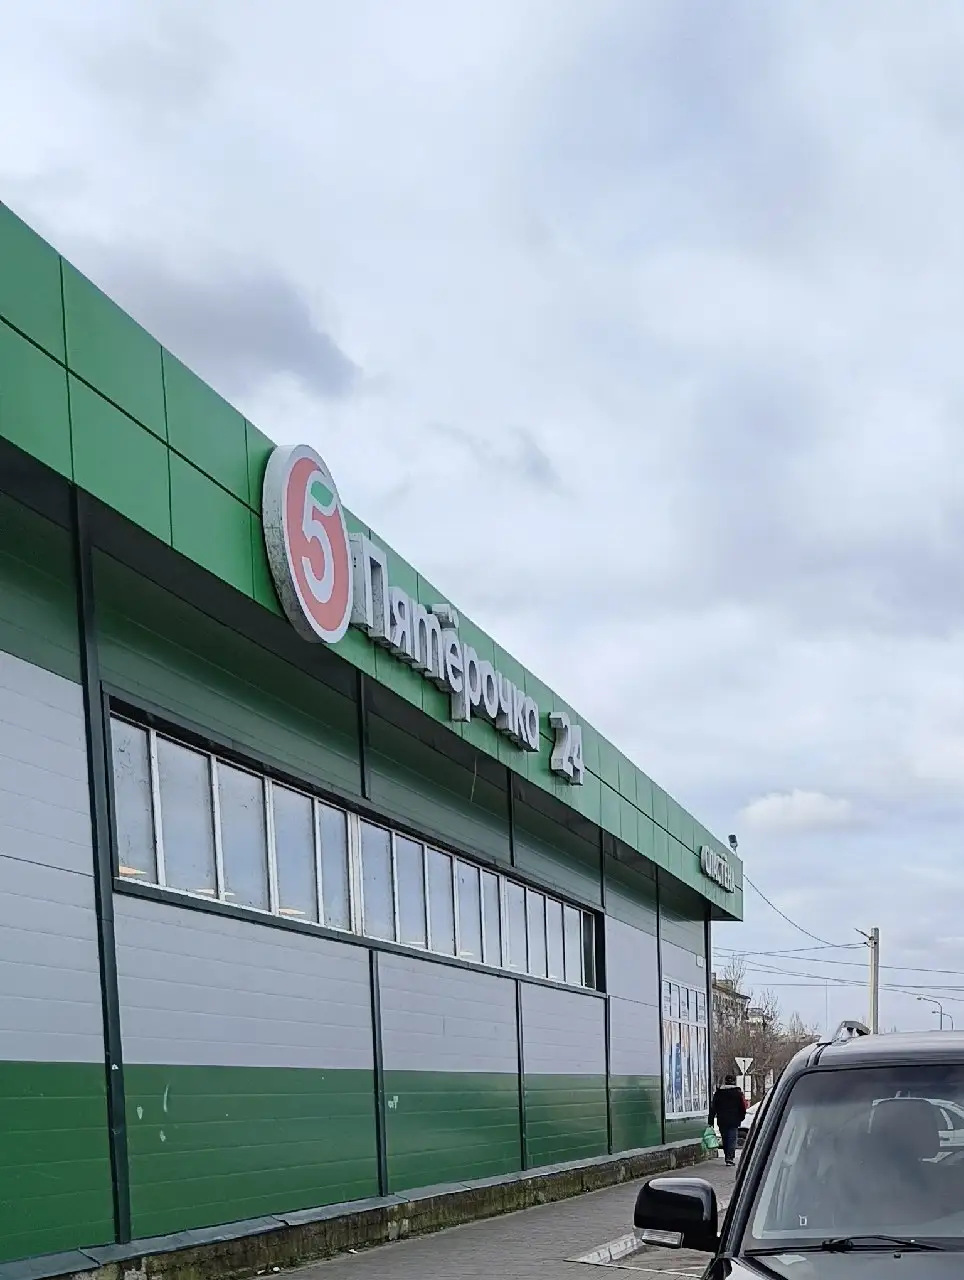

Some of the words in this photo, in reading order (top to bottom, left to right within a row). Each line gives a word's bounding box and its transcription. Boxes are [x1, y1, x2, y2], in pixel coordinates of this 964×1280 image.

[302, 470, 338, 604] 5
[351, 533, 540, 752] Пятёрочка
[549, 712, 586, 786] 24
